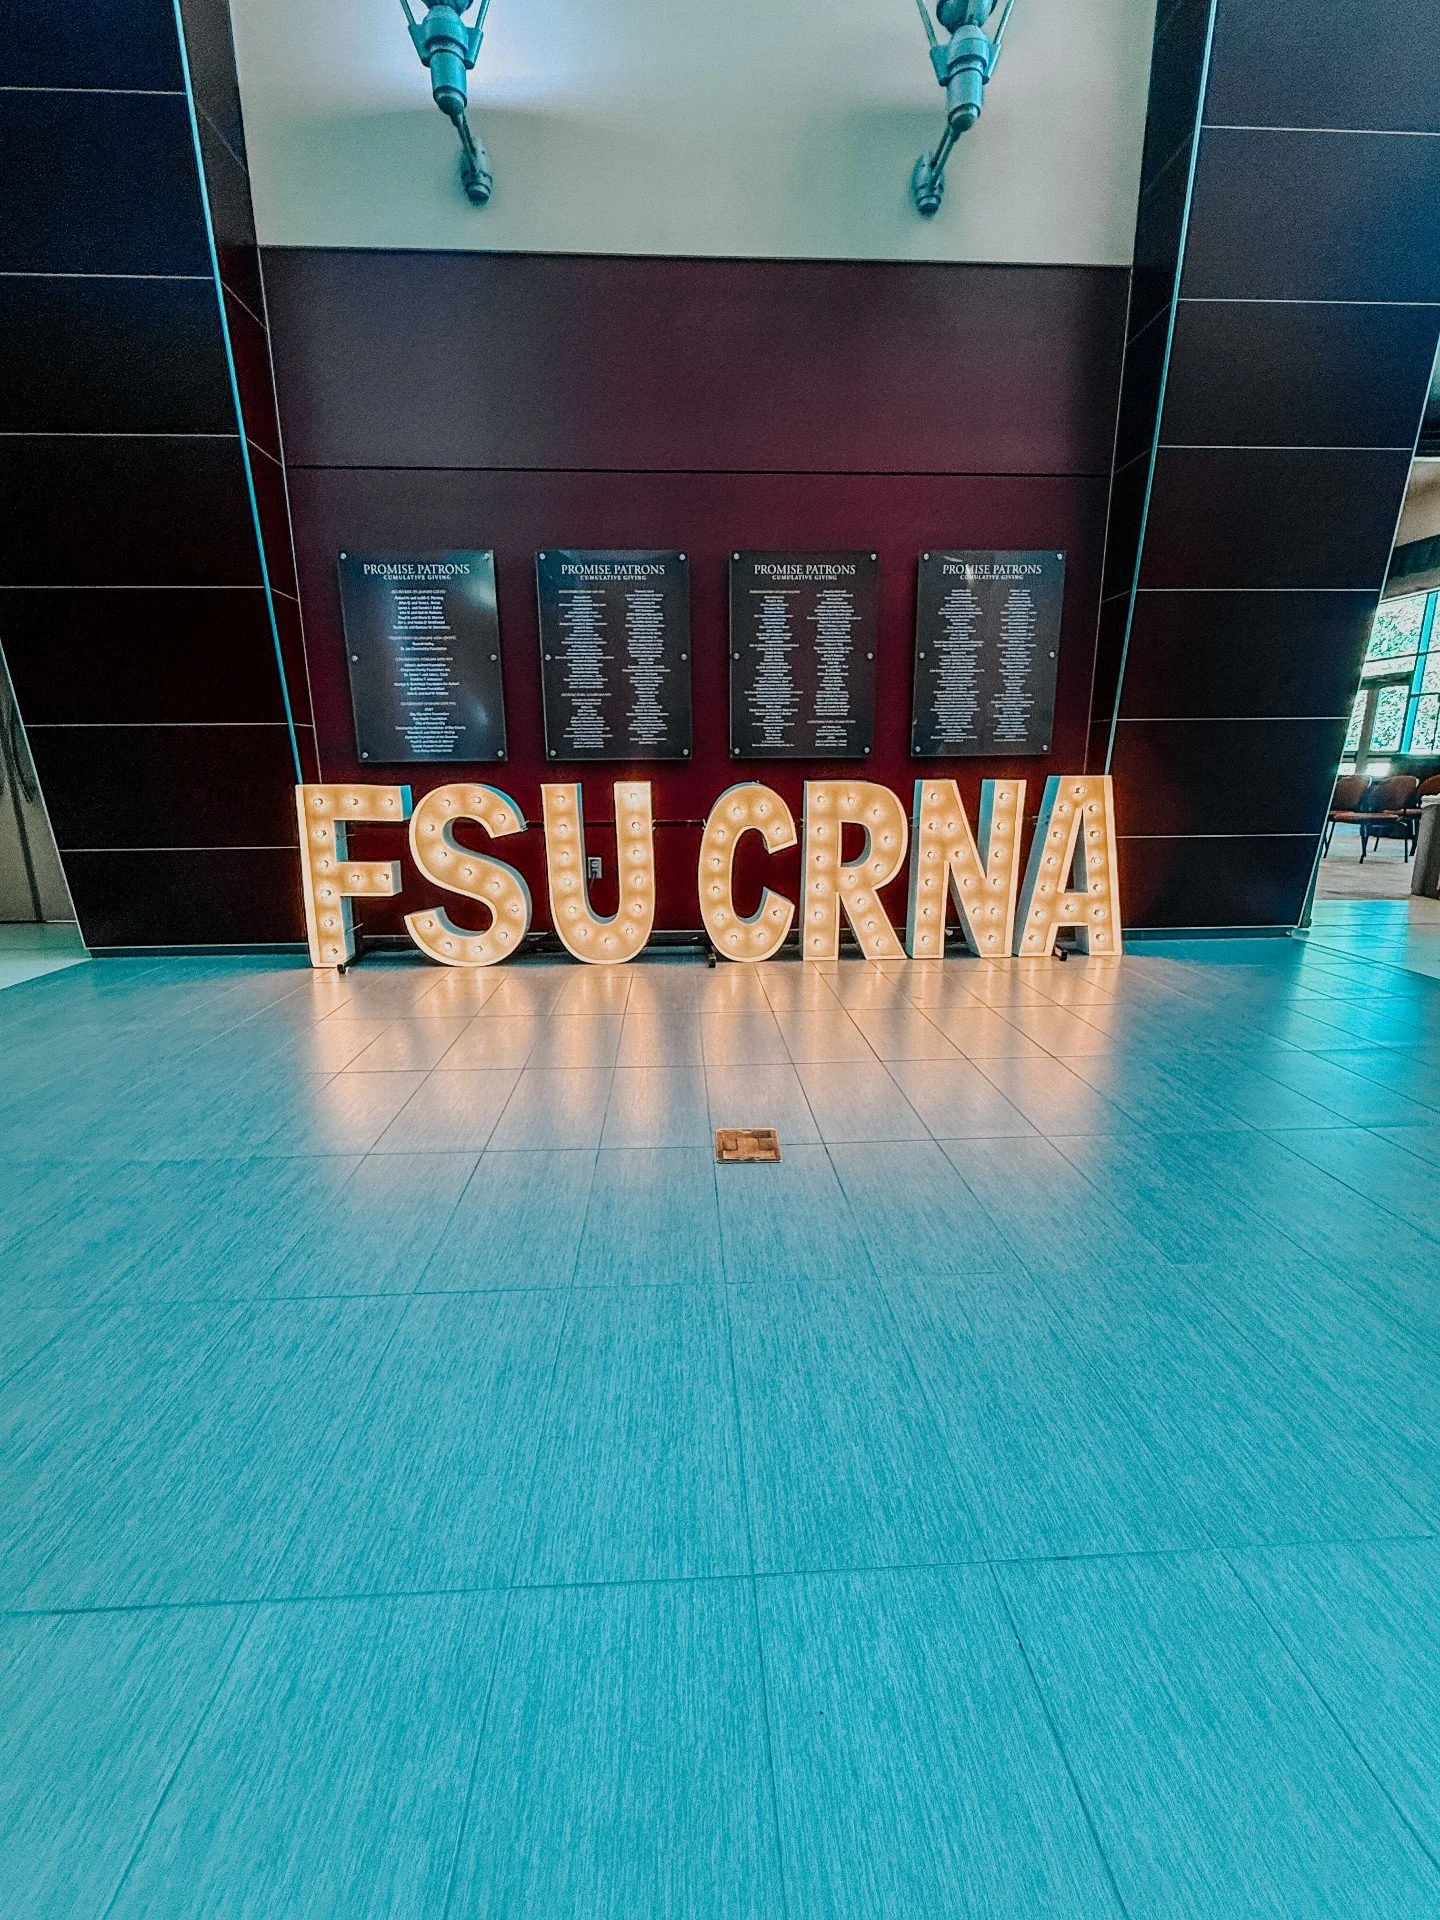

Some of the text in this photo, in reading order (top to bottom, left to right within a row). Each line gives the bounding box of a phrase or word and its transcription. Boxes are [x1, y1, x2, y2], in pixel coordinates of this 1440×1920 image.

[363, 563, 470, 575] PROMISE PATRONS
[561, 564, 665, 575] PROMISE PATRONS
[754, 564, 856, 575] PROMISE PATRONS
[942, 564, 1042, 575] PROMISE PATRONS
[295, 775, 1122, 967] FSU CRNA
